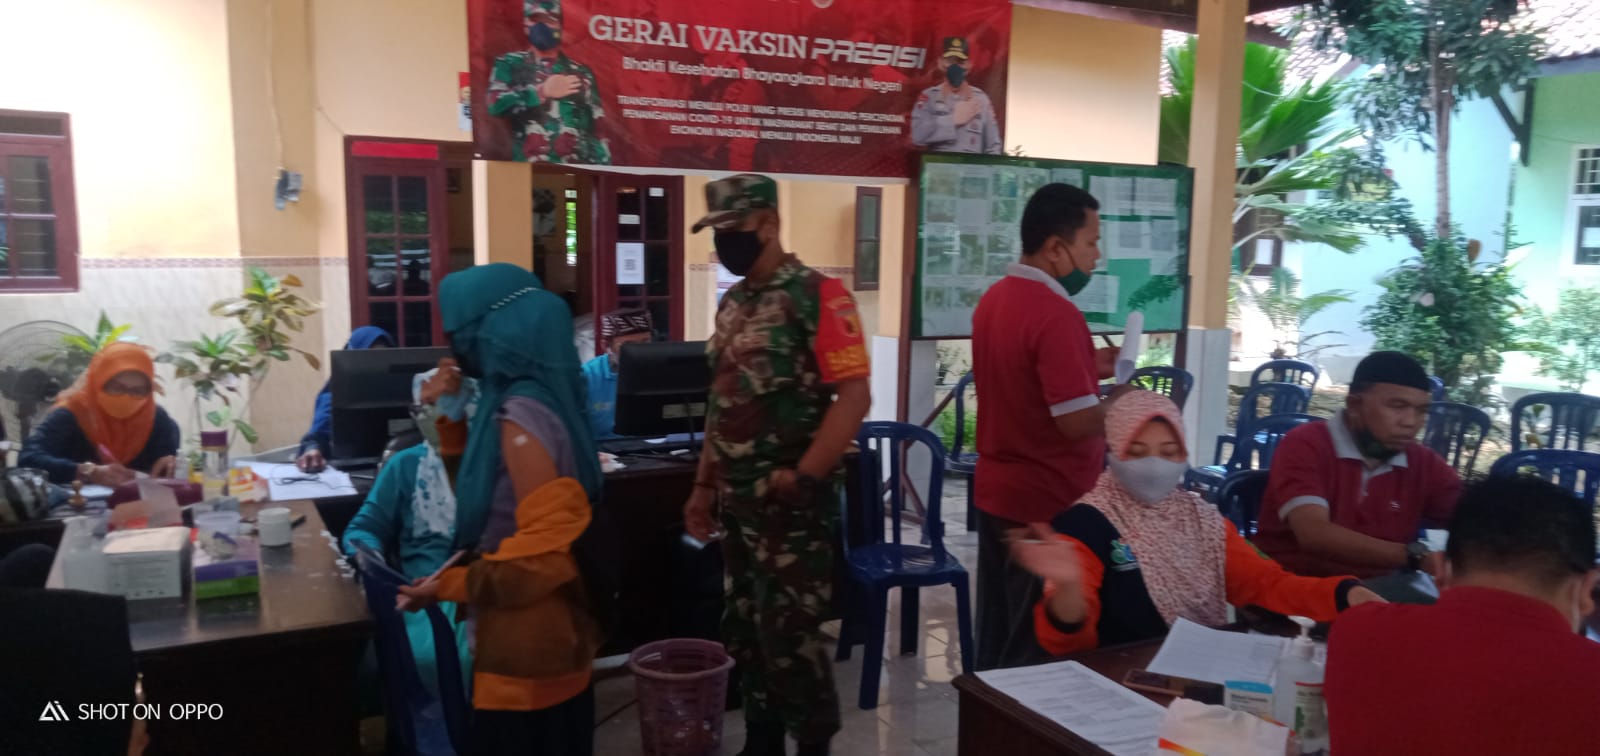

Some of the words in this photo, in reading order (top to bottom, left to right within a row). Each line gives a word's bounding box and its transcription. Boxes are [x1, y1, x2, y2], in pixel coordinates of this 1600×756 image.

[589, 14, 688, 48] GERAI
[697, 25, 808, 58] VAKSIN
[811, 38, 926, 69] PRESISI
[622, 57, 665, 73] Bhakti
[669, 61, 739, 79] Kesehatan
[743, 67, 825, 87] Bhayangkara
[828, 75, 861, 89] Untuk
[864, 77, 902, 93] Negeri
